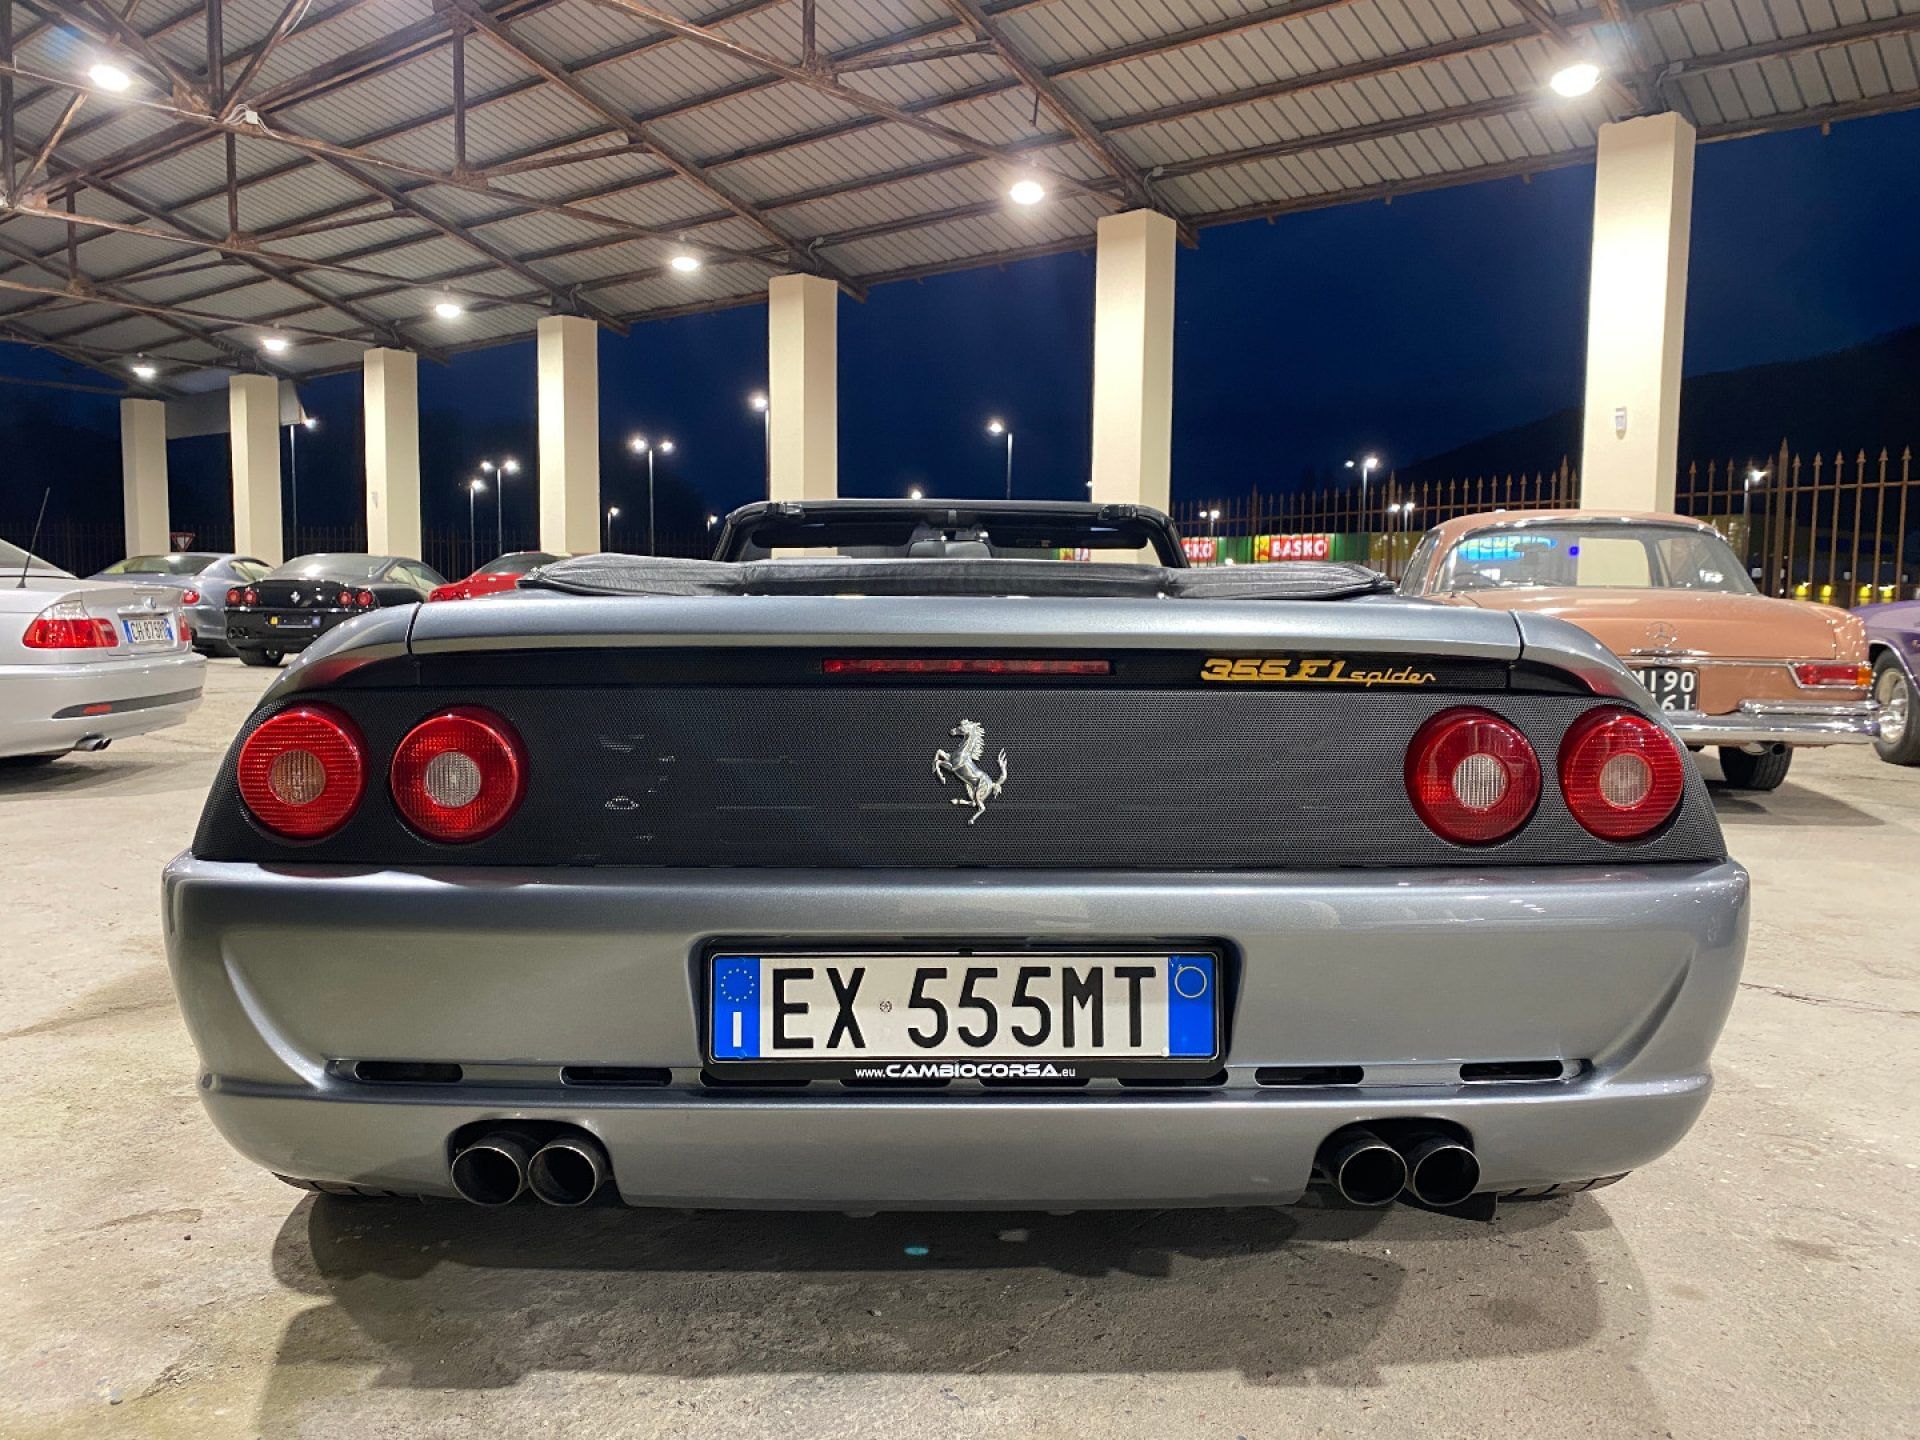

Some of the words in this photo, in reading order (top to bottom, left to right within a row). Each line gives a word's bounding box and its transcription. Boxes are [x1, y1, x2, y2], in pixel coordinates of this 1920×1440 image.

[1183, 543, 1213, 559] SKO
[1271, 540, 1328, 557] BASKO
[1201, 659, 1290, 681] 355
[1292, 659, 1346, 681] F1
[1350, 667, 1436, 687] spider
[1663, 671, 1695, 693] 90
[773, 967, 866, 1049] EX
[907, 966, 1157, 1049] 555MT
[733, 1011, 742, 1048] I
[855, 1063, 1076, 1078] www.CAMBIOCORSA.eu
